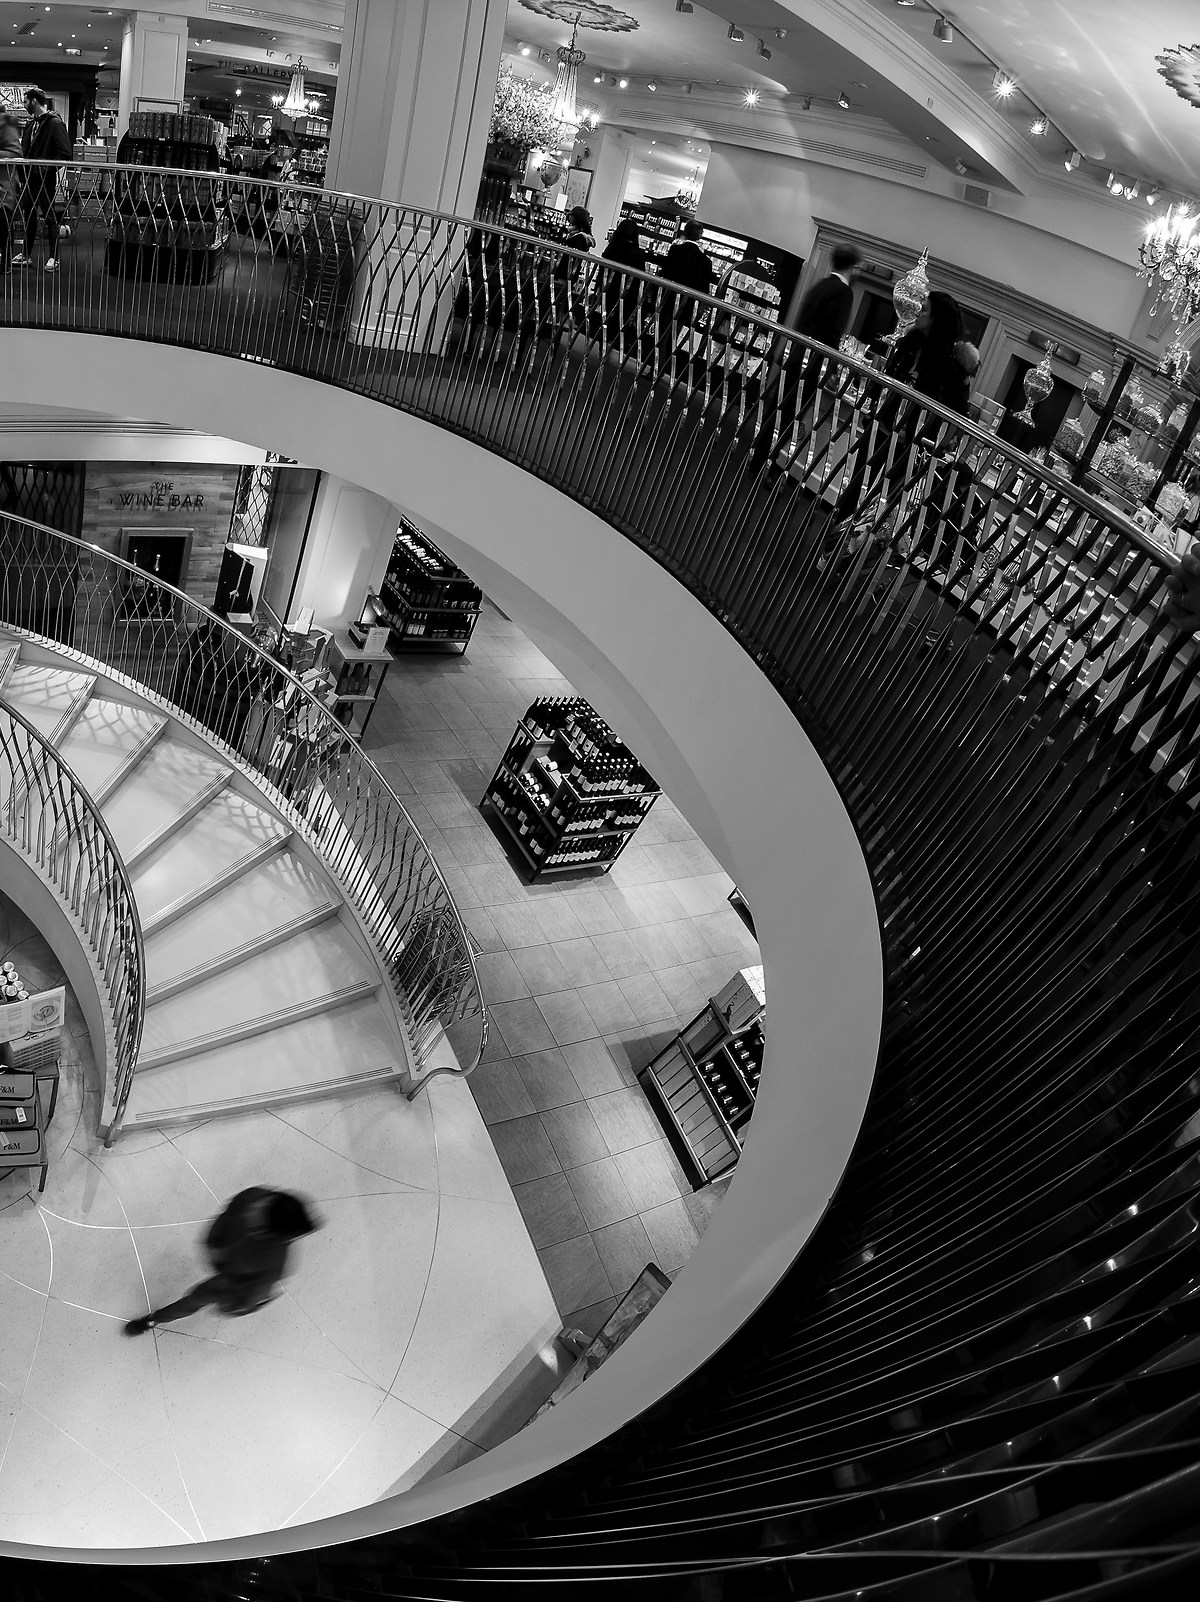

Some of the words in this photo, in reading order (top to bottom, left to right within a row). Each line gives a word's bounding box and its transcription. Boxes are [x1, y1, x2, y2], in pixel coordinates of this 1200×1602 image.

[244, 65, 294, 80] GALLERY
[154, 482, 174, 491] THE
[120, 493, 166, 507] WINE
[171, 494, 204, 507] BAR
